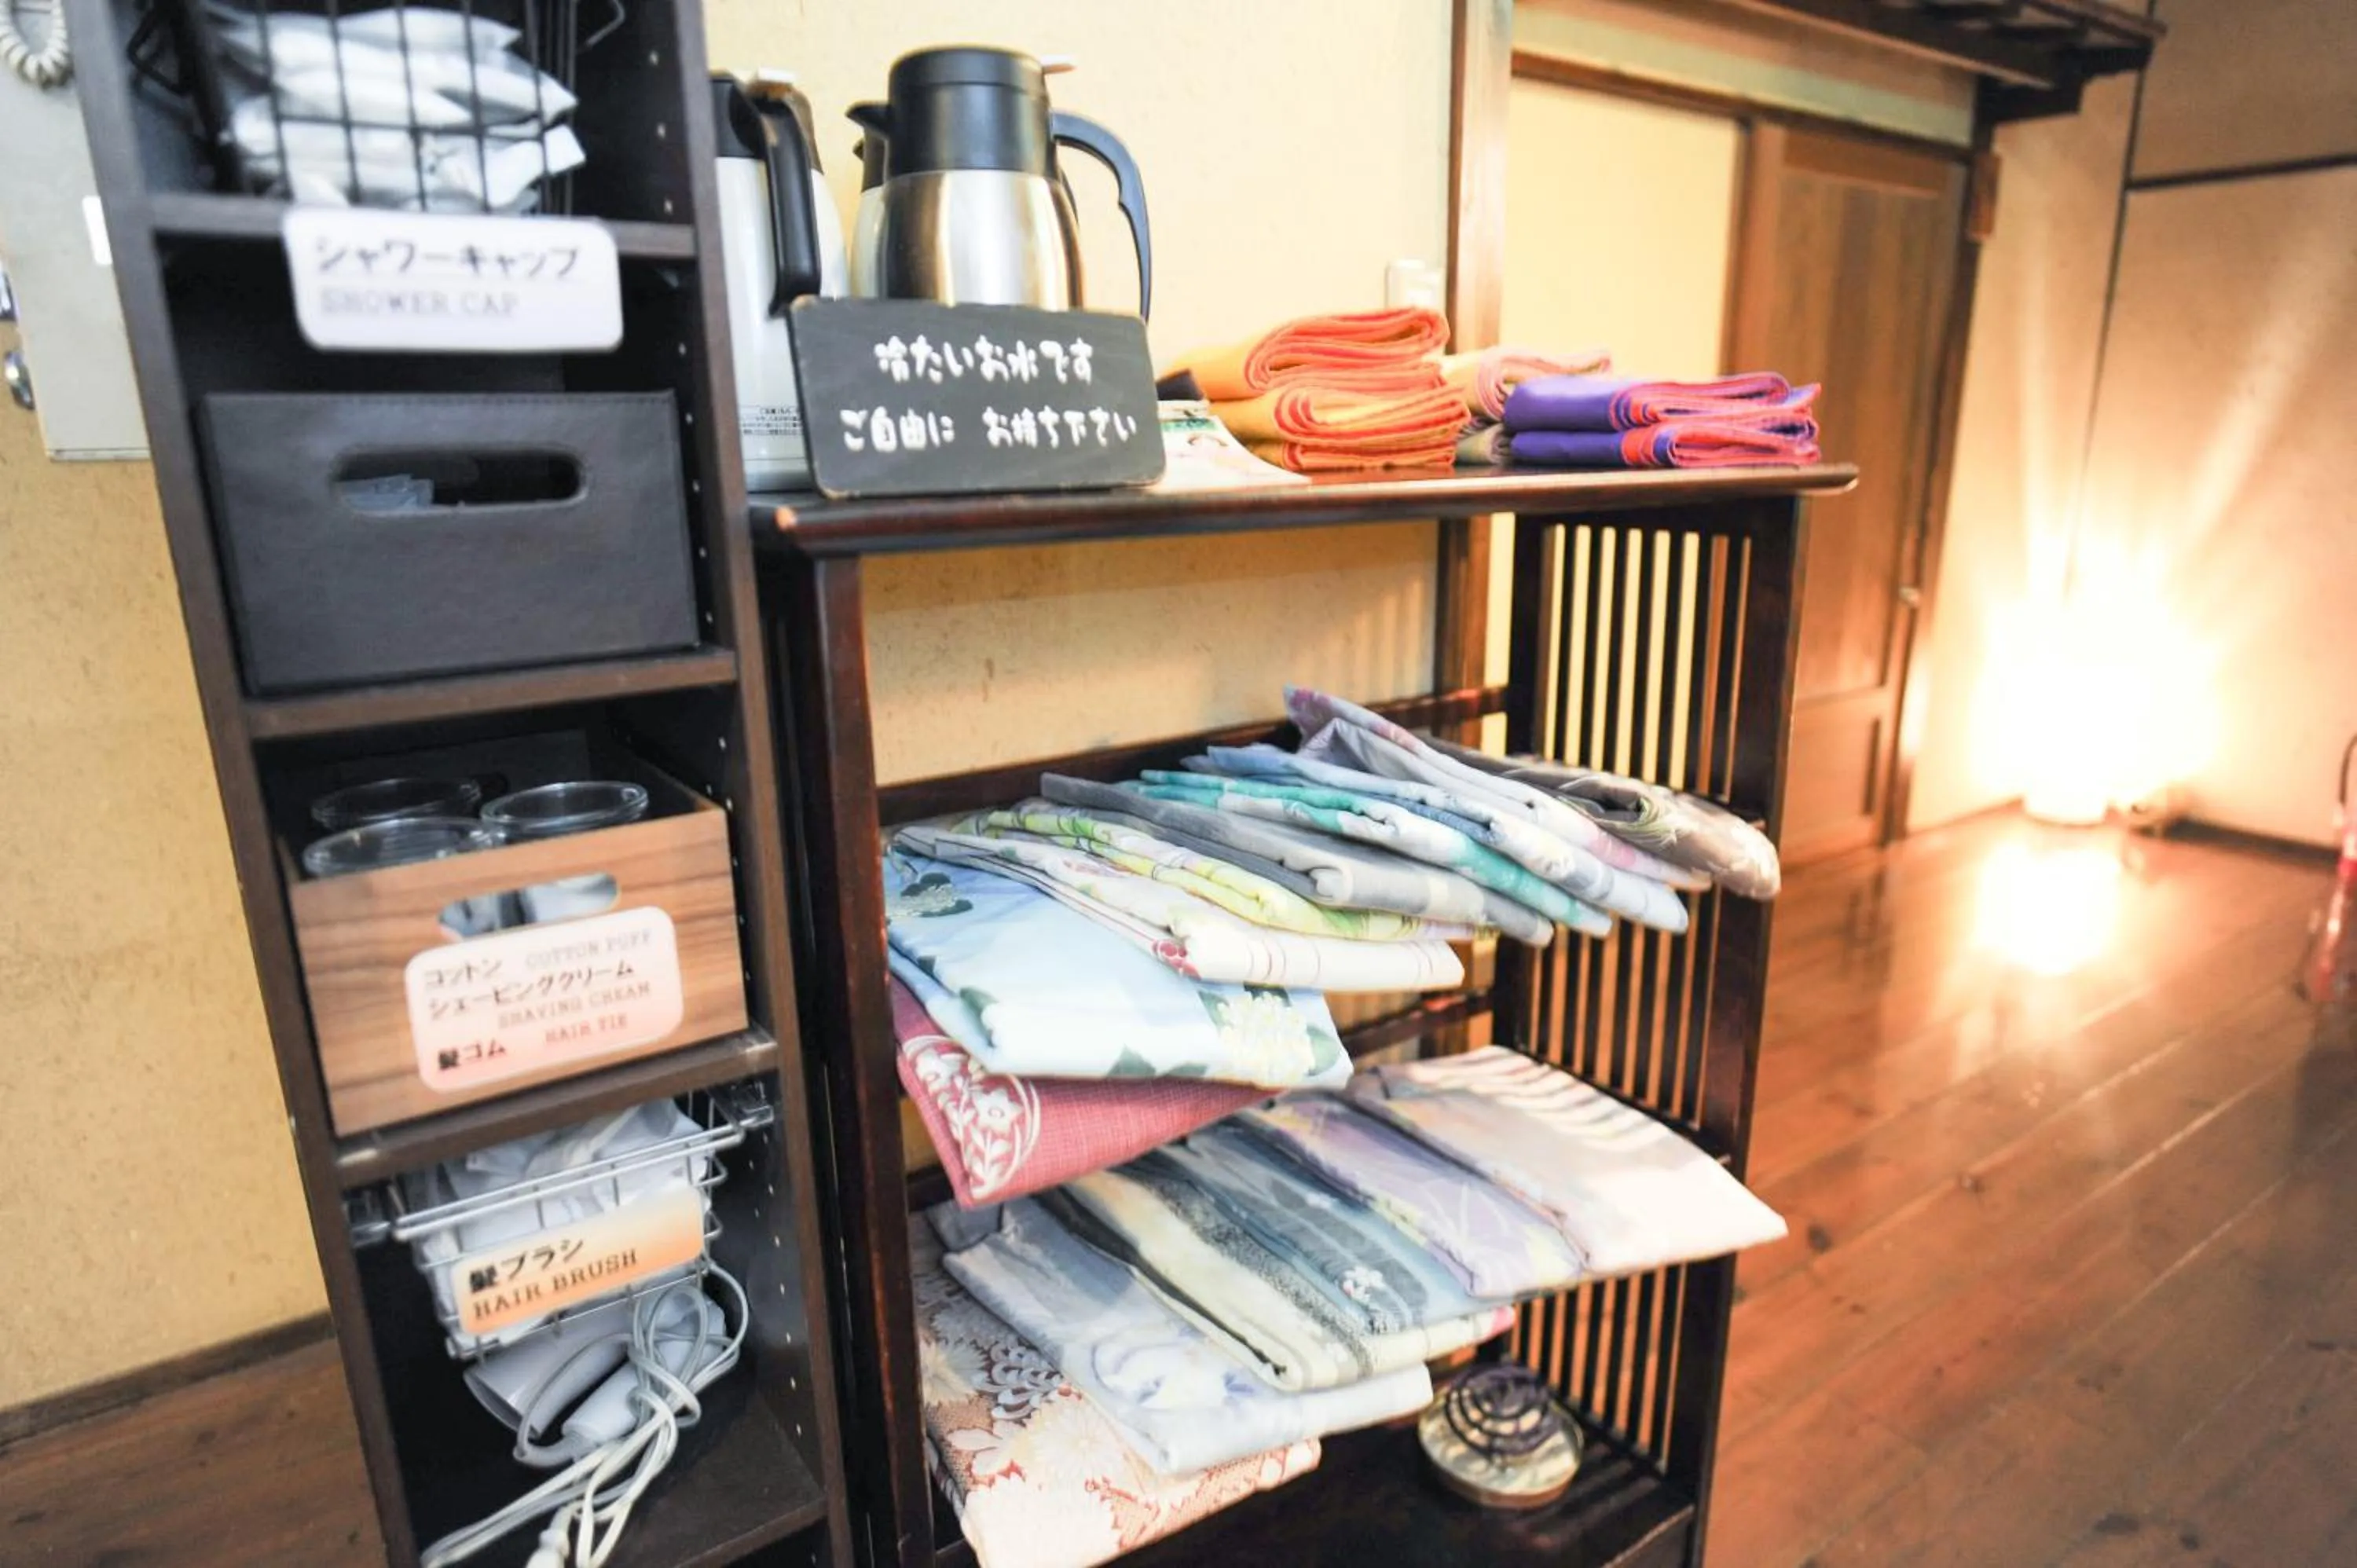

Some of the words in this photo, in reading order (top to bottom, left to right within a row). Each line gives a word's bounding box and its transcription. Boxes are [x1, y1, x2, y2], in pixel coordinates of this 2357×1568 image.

[316, 237, 578, 277] シャワーキャップ
[320, 288, 447, 313] SHOWER
[460, 290, 520, 313] CAP
[474, 1283, 542, 1321] HAIR
[553, 1248, 637, 1291] BRUSH
